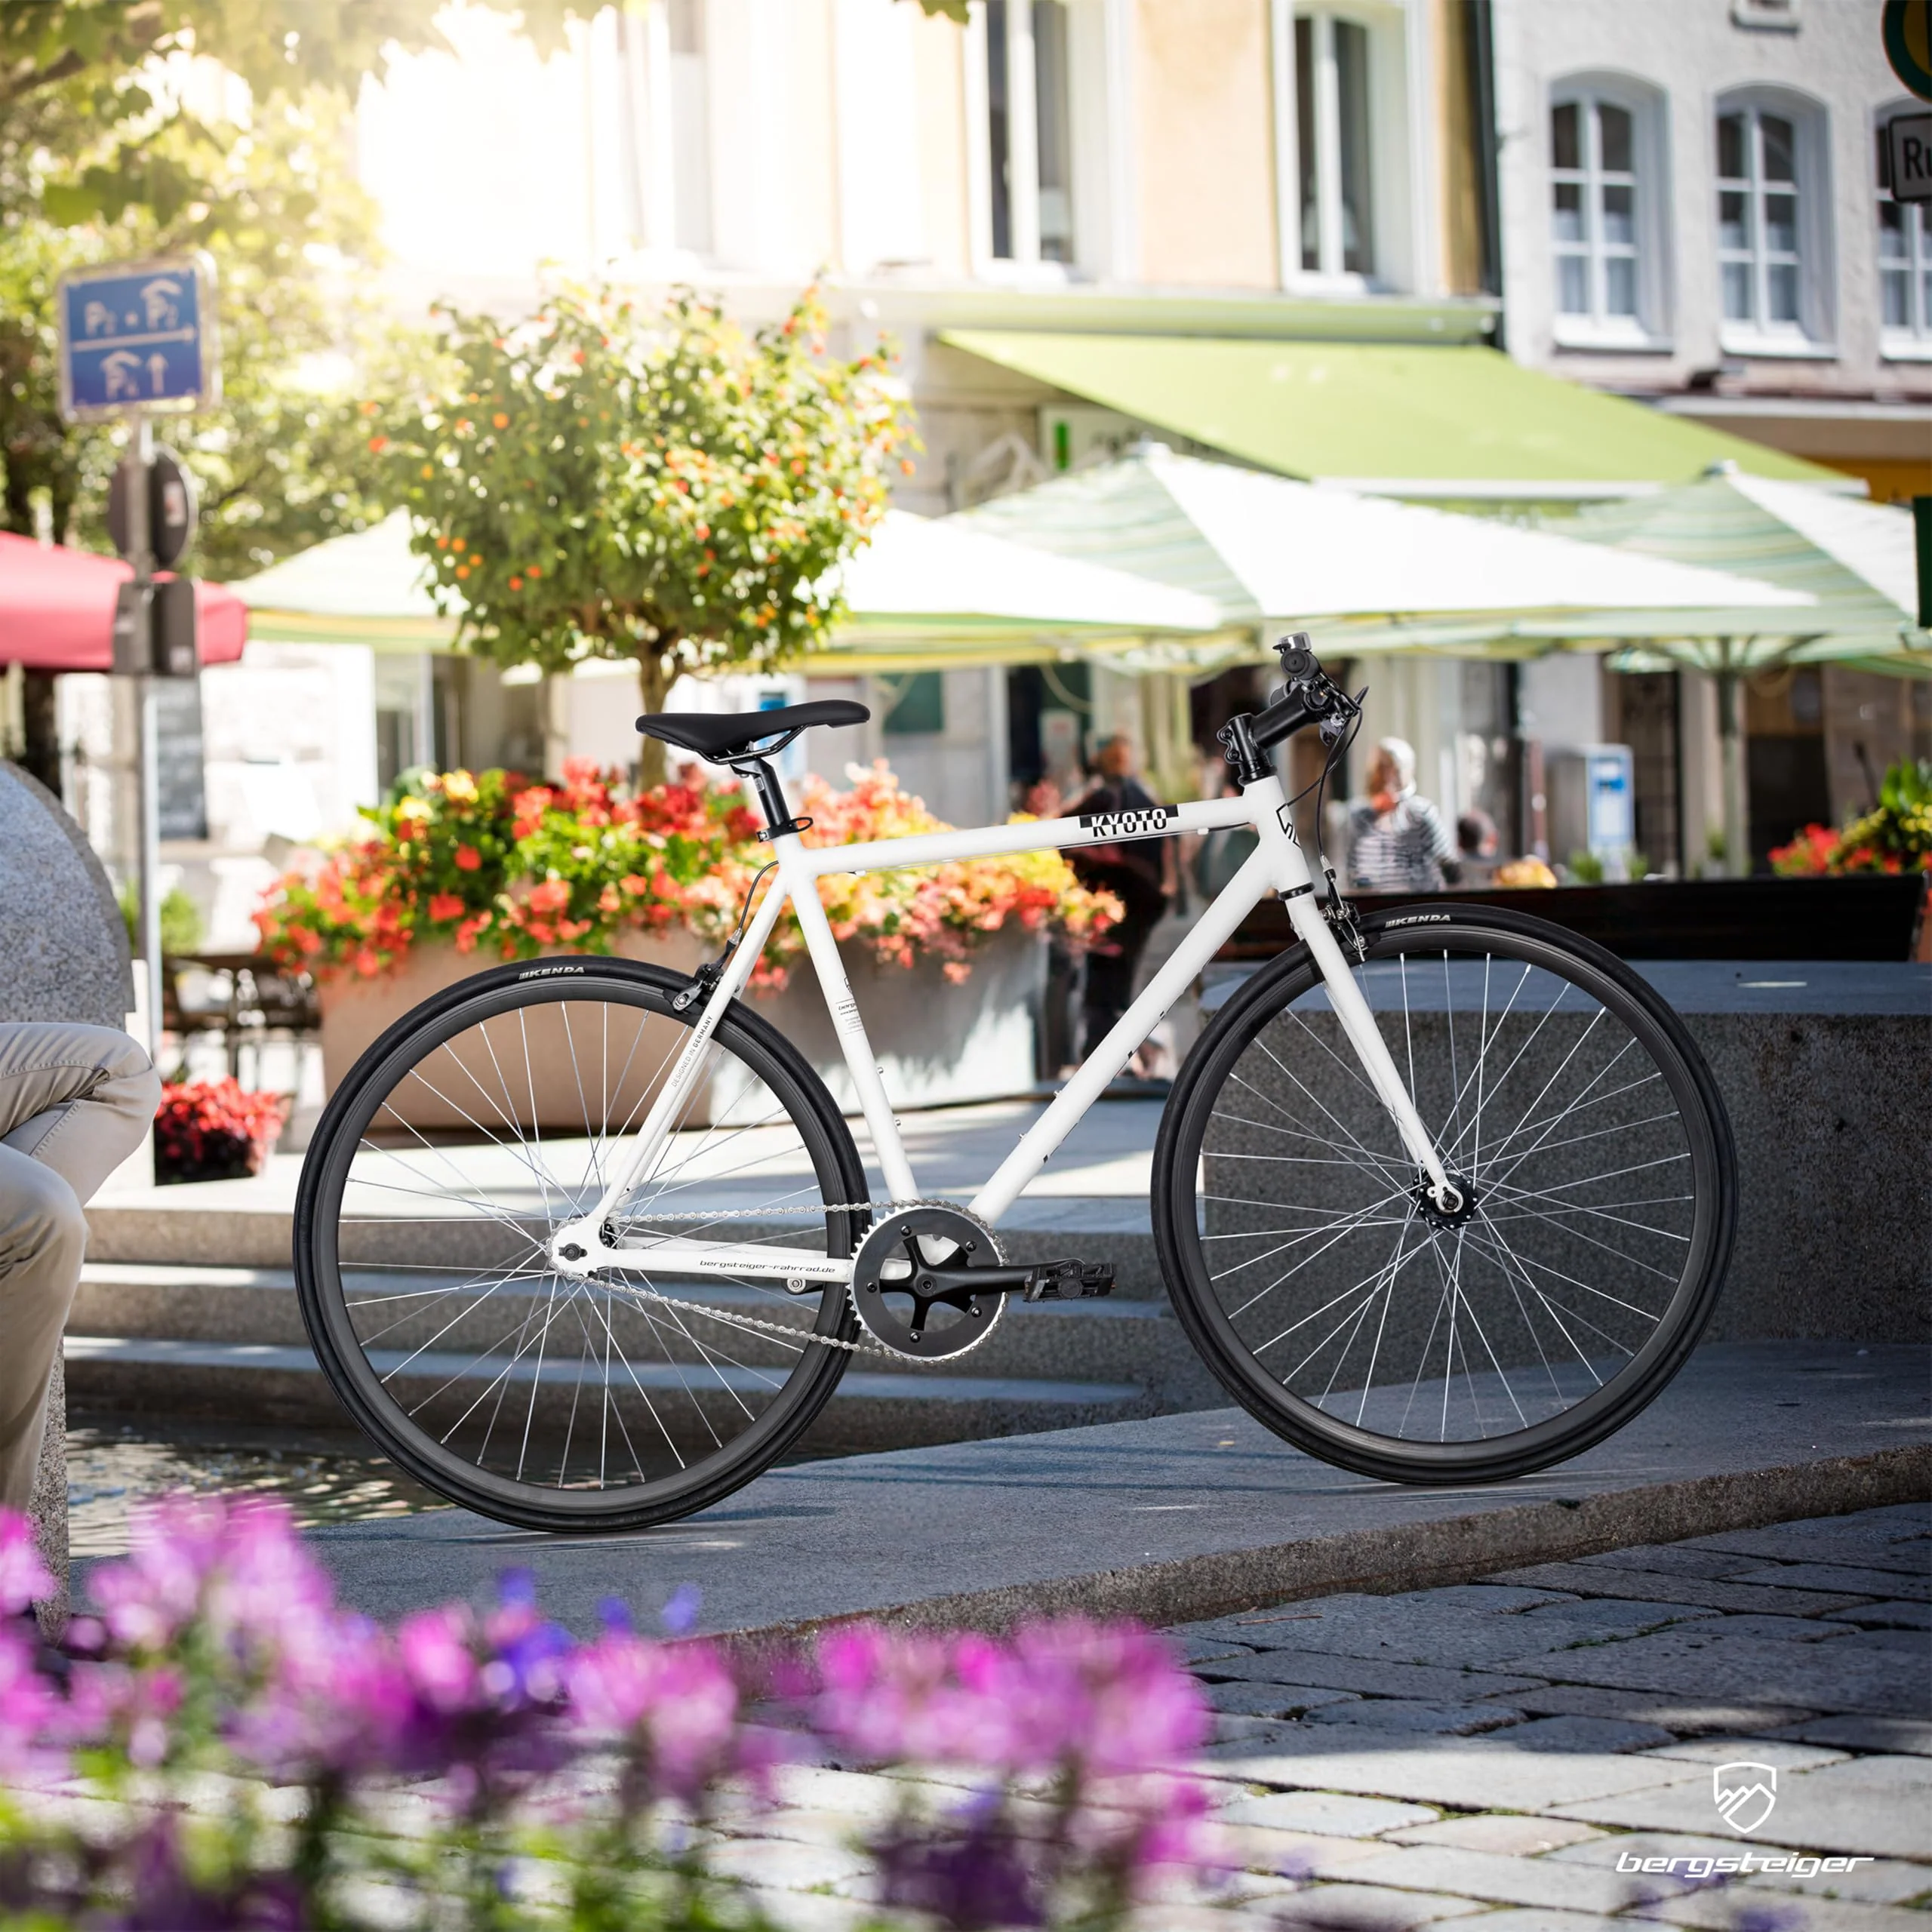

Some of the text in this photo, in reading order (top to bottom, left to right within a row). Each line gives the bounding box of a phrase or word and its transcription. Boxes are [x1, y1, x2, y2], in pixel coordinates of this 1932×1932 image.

[1091, 808, 1167, 837] KYOTO
[1395, 914, 1451, 926] KENDA
[528, 967, 585, 977] KENDA
[671, 1015, 713, 1088] DESIGNED IN GERMANY
[700, 1260, 835, 1273] bergsteiger-fahrrad.de
